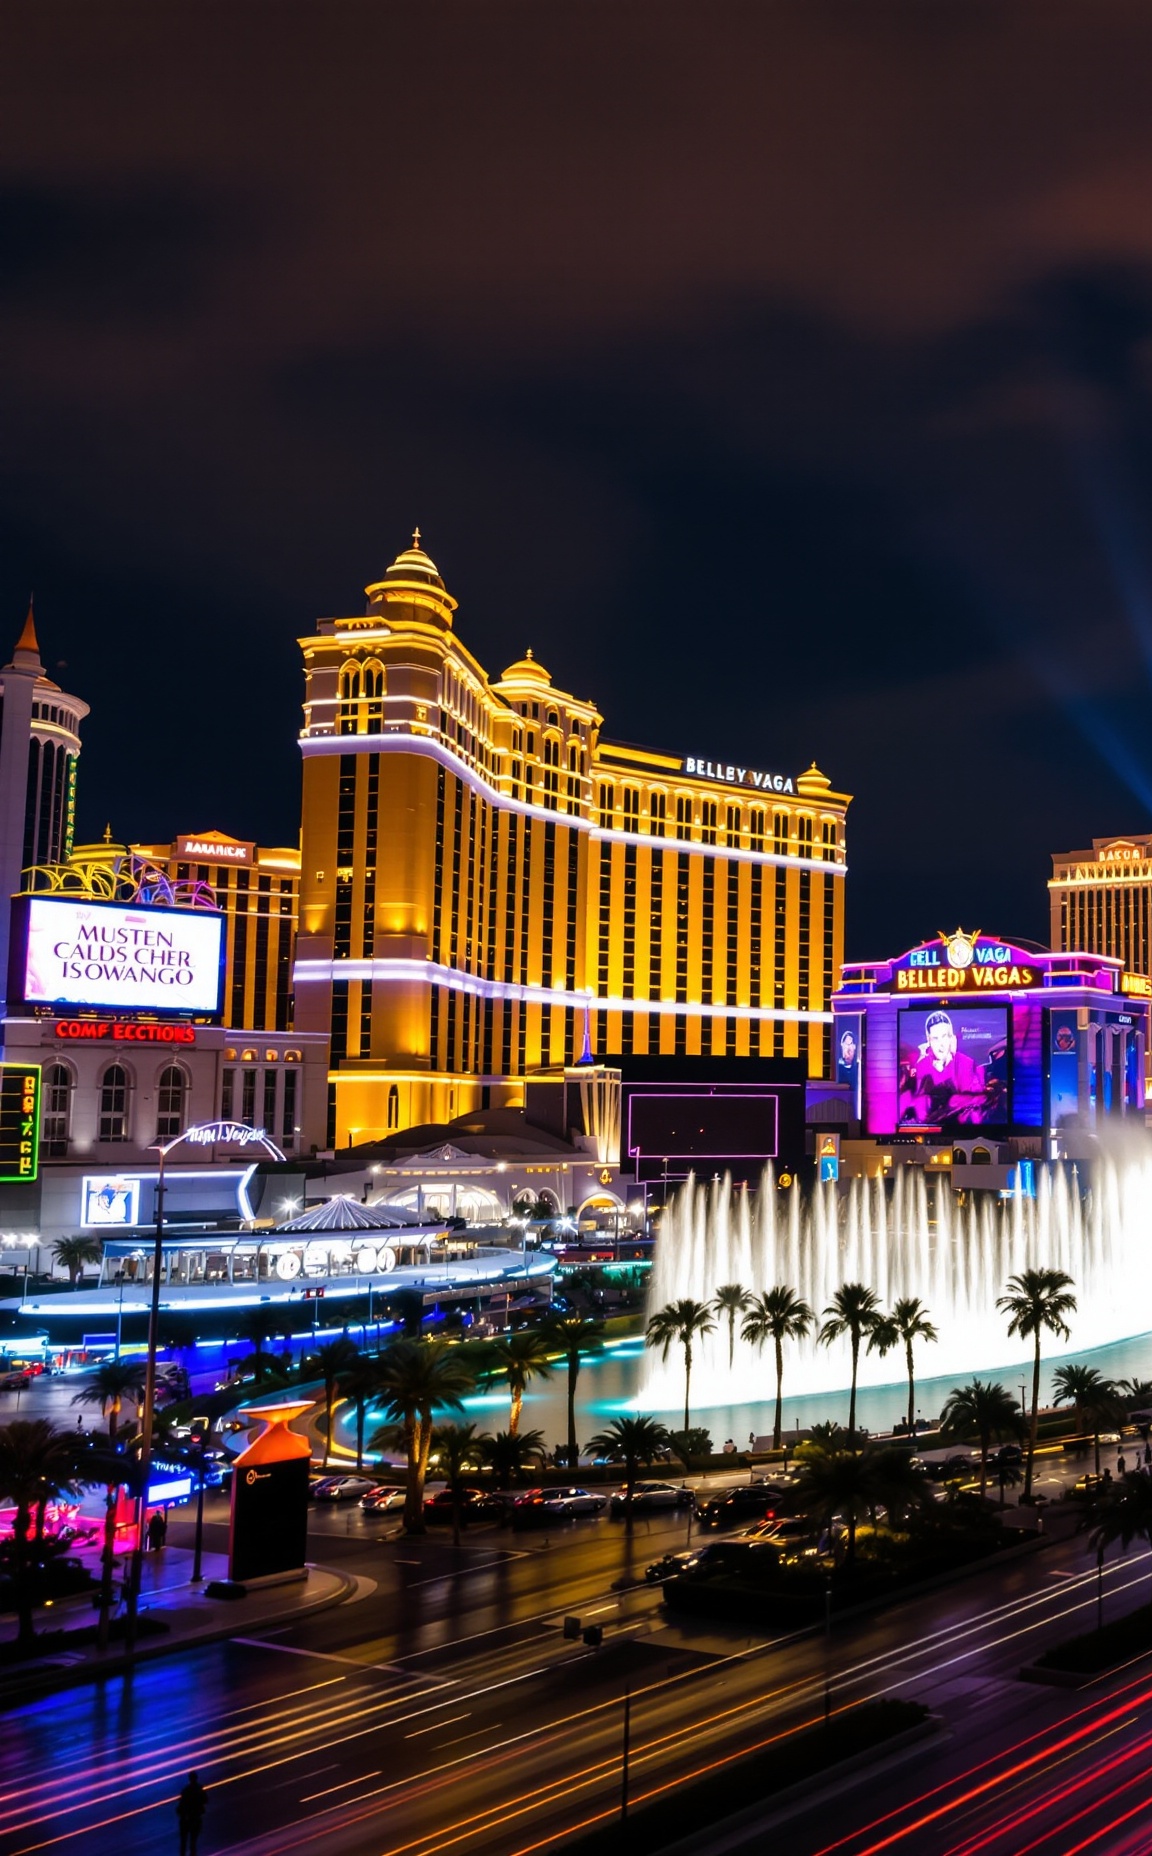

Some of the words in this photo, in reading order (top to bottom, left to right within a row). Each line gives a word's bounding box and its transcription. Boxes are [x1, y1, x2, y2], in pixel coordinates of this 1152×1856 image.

[686, 757, 747, 783] BELLEY
[752, 771, 793, 793] VAGA
[77, 924, 174, 948] MUSTEN
[53, 941, 128, 963] CALDS
[134, 948, 196, 968] CHER
[62, 961, 194, 986] ISOWANGO
